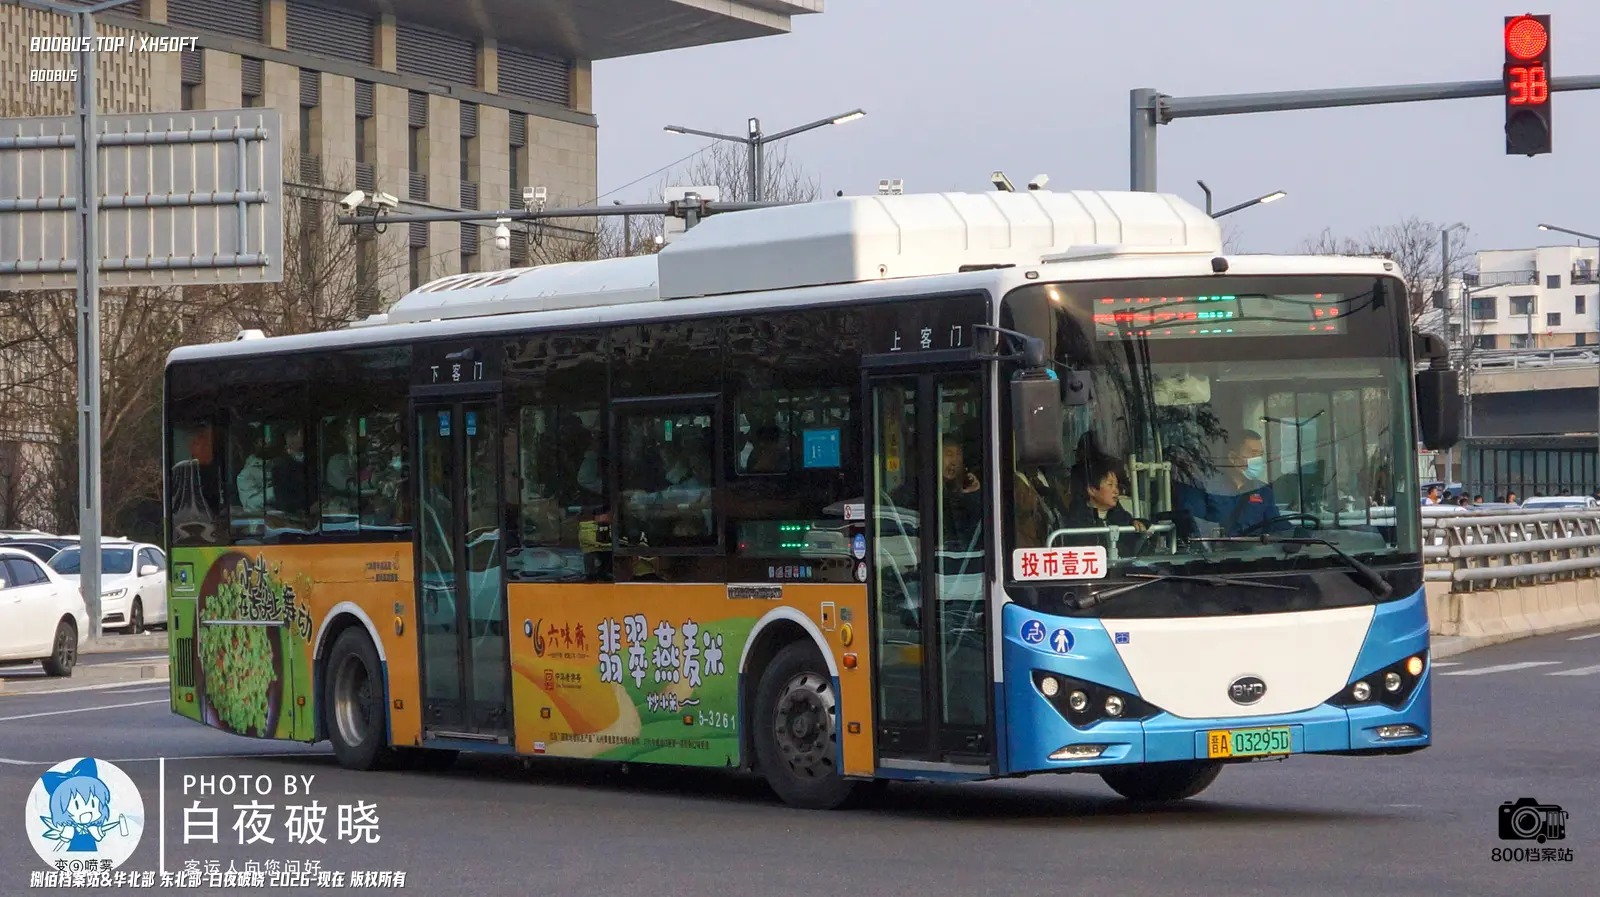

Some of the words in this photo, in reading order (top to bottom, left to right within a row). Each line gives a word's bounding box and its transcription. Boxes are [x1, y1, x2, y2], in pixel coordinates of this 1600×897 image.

[1509, 66, 1548, 105] 38
[890, 325, 962, 351] 上客门
[430, 361, 483, 383] 下客门
[1021, 551, 1099, 577] 投币壹元
[597, 613, 724, 689] 翡翠燕麦米
[1233, 683, 1263, 696] BYD
[698, 710, 736, 730] 5-3261
